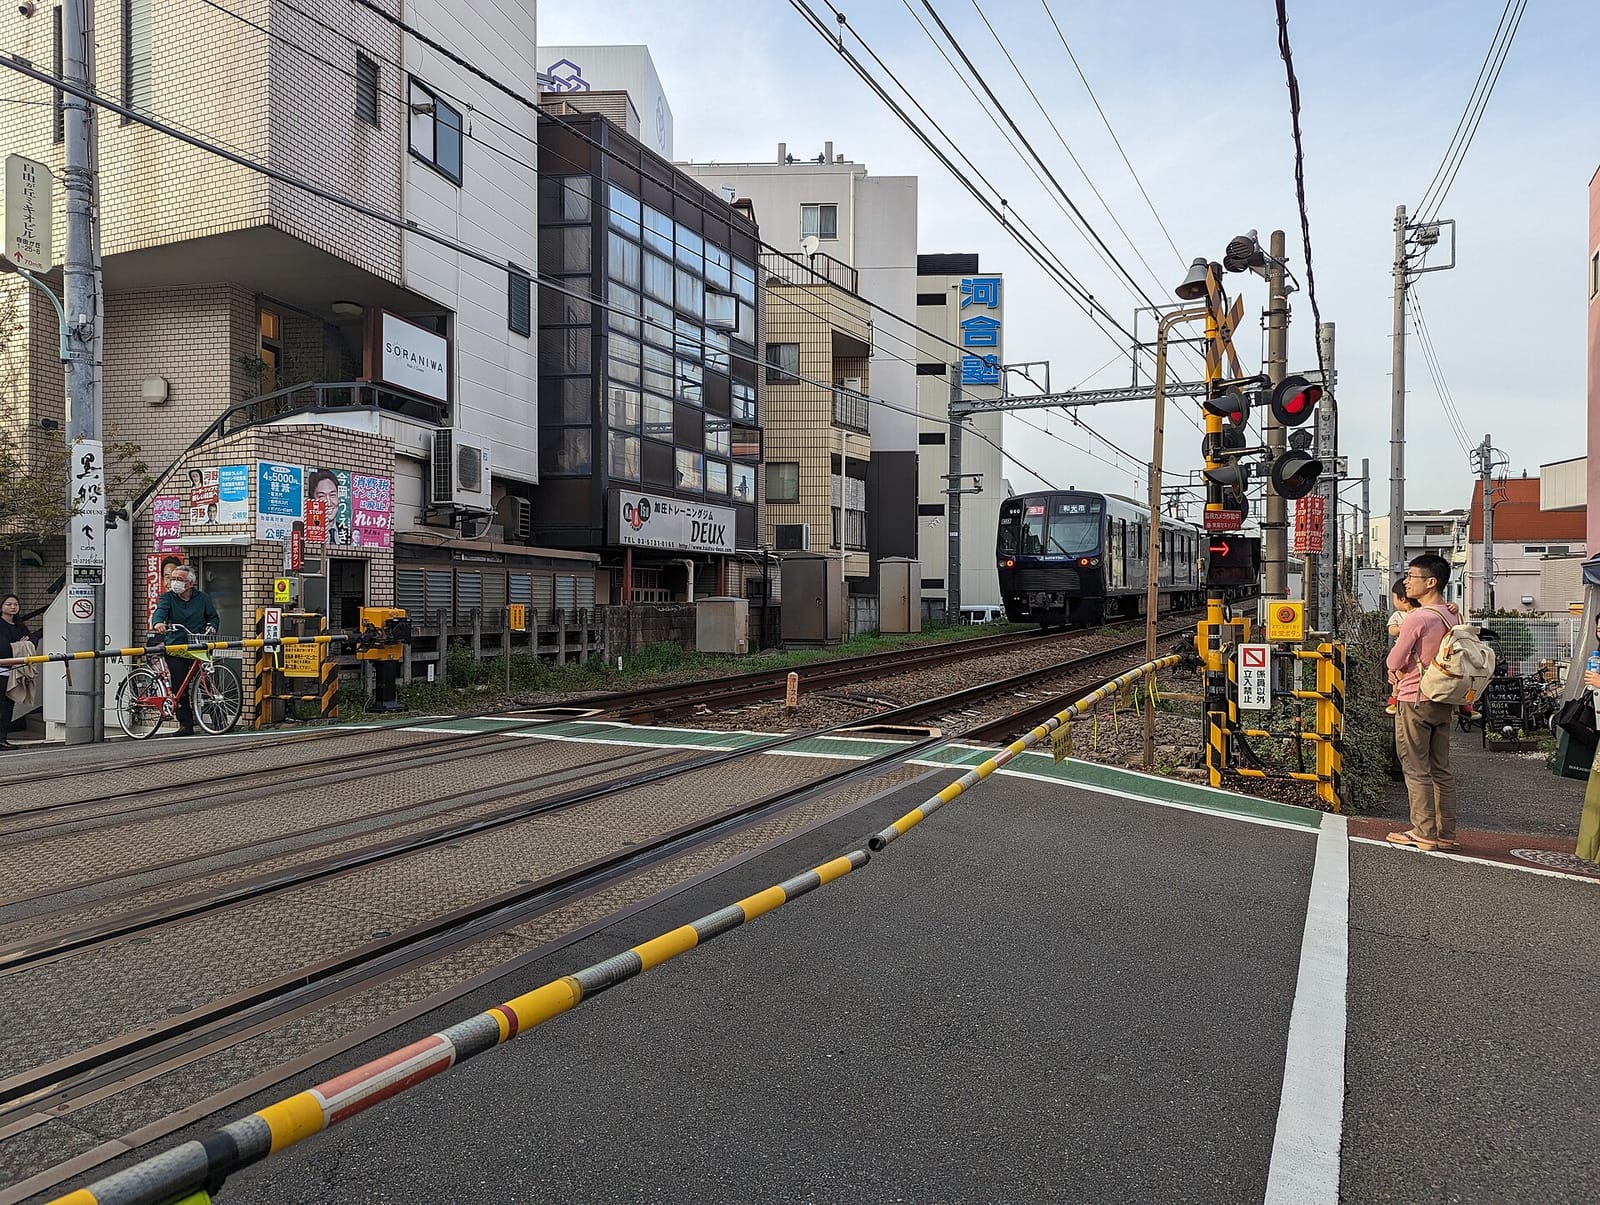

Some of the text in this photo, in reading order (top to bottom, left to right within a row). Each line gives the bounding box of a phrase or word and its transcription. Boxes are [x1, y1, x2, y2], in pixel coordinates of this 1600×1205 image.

[960, 277, 1001, 385] 河合塾
[385, 342, 444, 373] SORANIWA
[353, 475, 391, 490] 消費税
[352, 487, 390, 501] インボイス
[191, 508, 206, 519] 河野
[354, 511, 387, 528] れいわ
[654, 501, 713, 520] 加圧トレーニングジム
[624, 536, 635, 544] TEL
[691, 520, 726, 546] DEUX
[1243, 669, 1253, 704] 立入禁止
[1256, 669, 1266, 704] 係員以外
[1488, 684, 1506, 692] BAR
